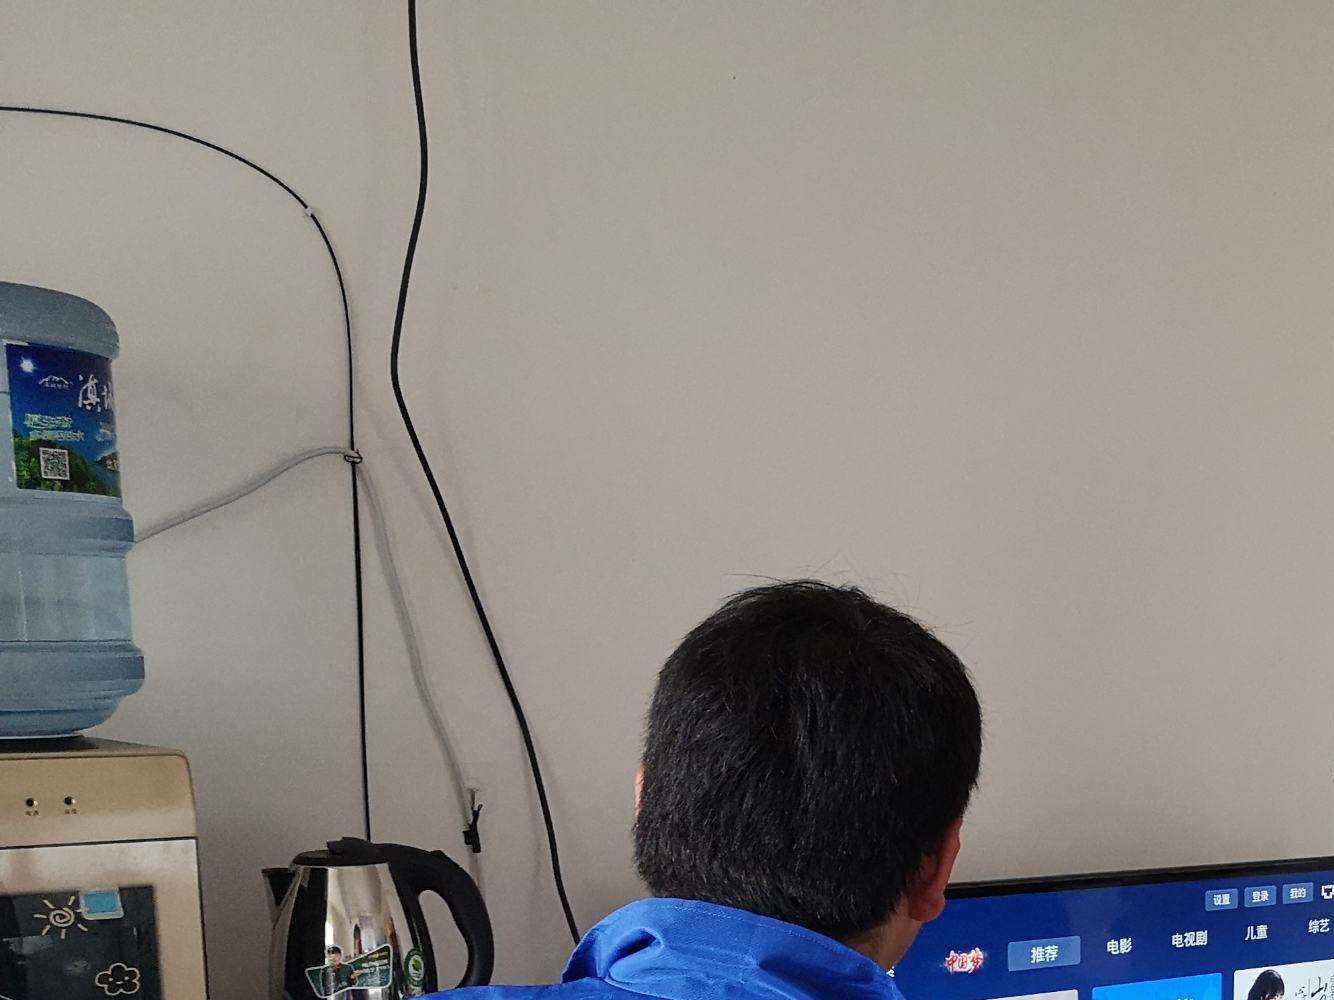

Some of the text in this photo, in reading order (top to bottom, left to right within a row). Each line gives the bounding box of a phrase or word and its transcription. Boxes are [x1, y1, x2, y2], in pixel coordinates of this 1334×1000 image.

[1213, 893, 1231, 906] 设置
[1252, 890, 1269, 903] 登录
[1245, 925, 1268, 941] 儿童
[1308, 919, 1330, 934] 综艺
[1107, 937, 1132, 955] 电影
[1172, 929, 1208, 948] 电视剧
[1031, 945, 1058, 964] 推荐
